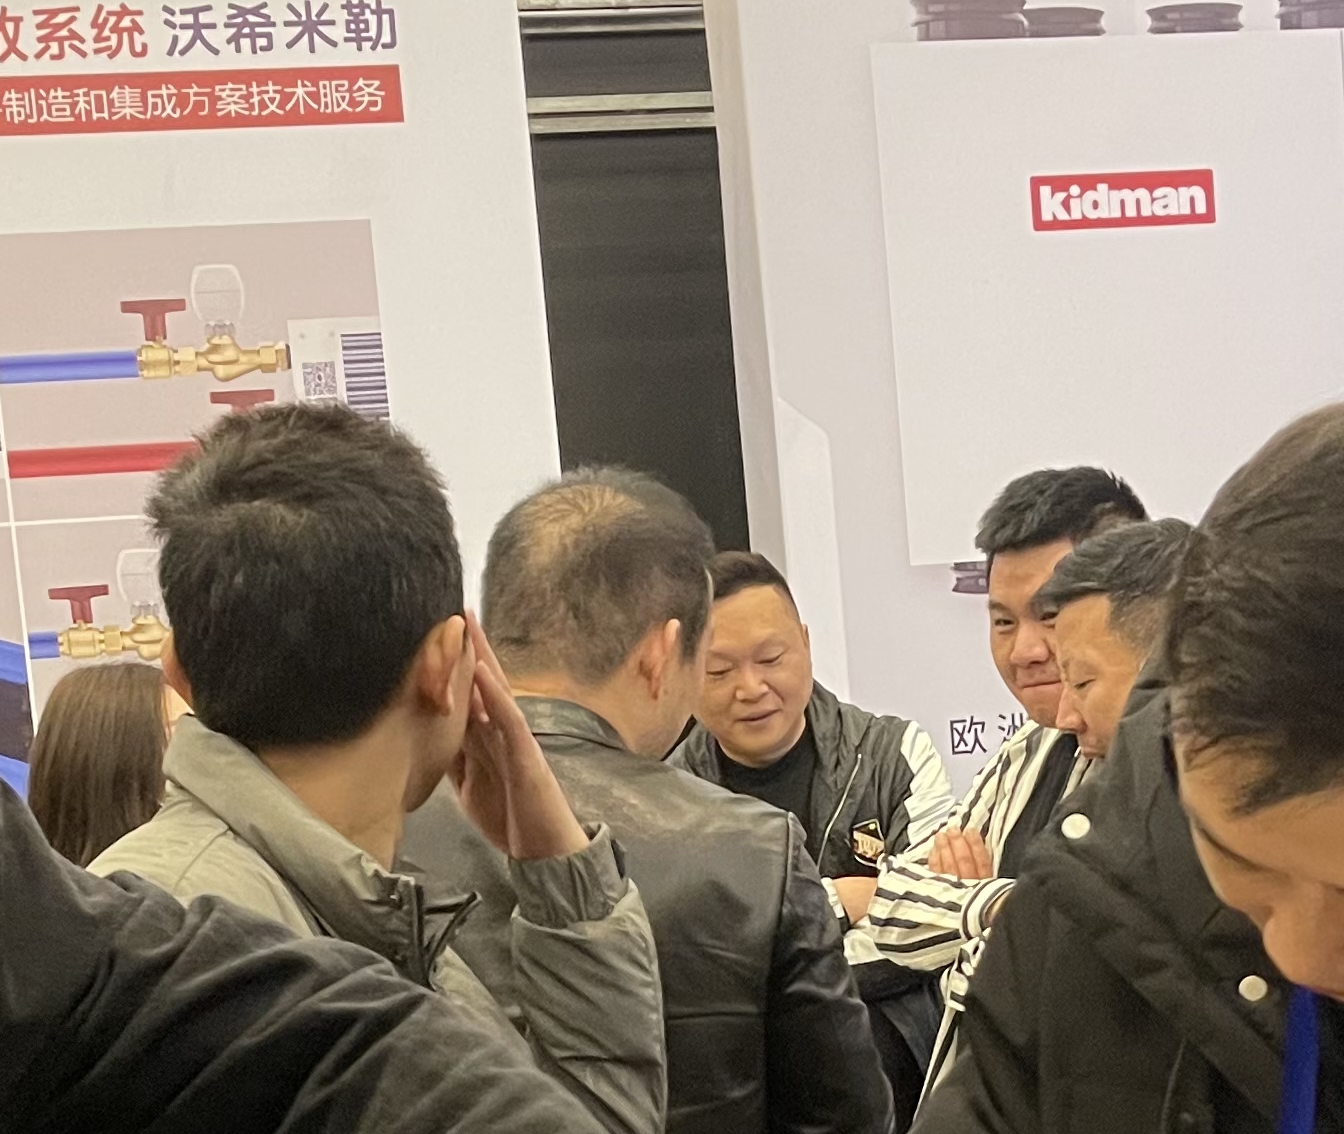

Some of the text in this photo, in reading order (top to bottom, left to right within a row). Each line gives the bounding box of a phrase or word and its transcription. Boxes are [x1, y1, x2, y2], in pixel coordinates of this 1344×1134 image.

[162, 0, 398, 58] 沃希米勒
[1039, 183, 1207, 222] kidman
